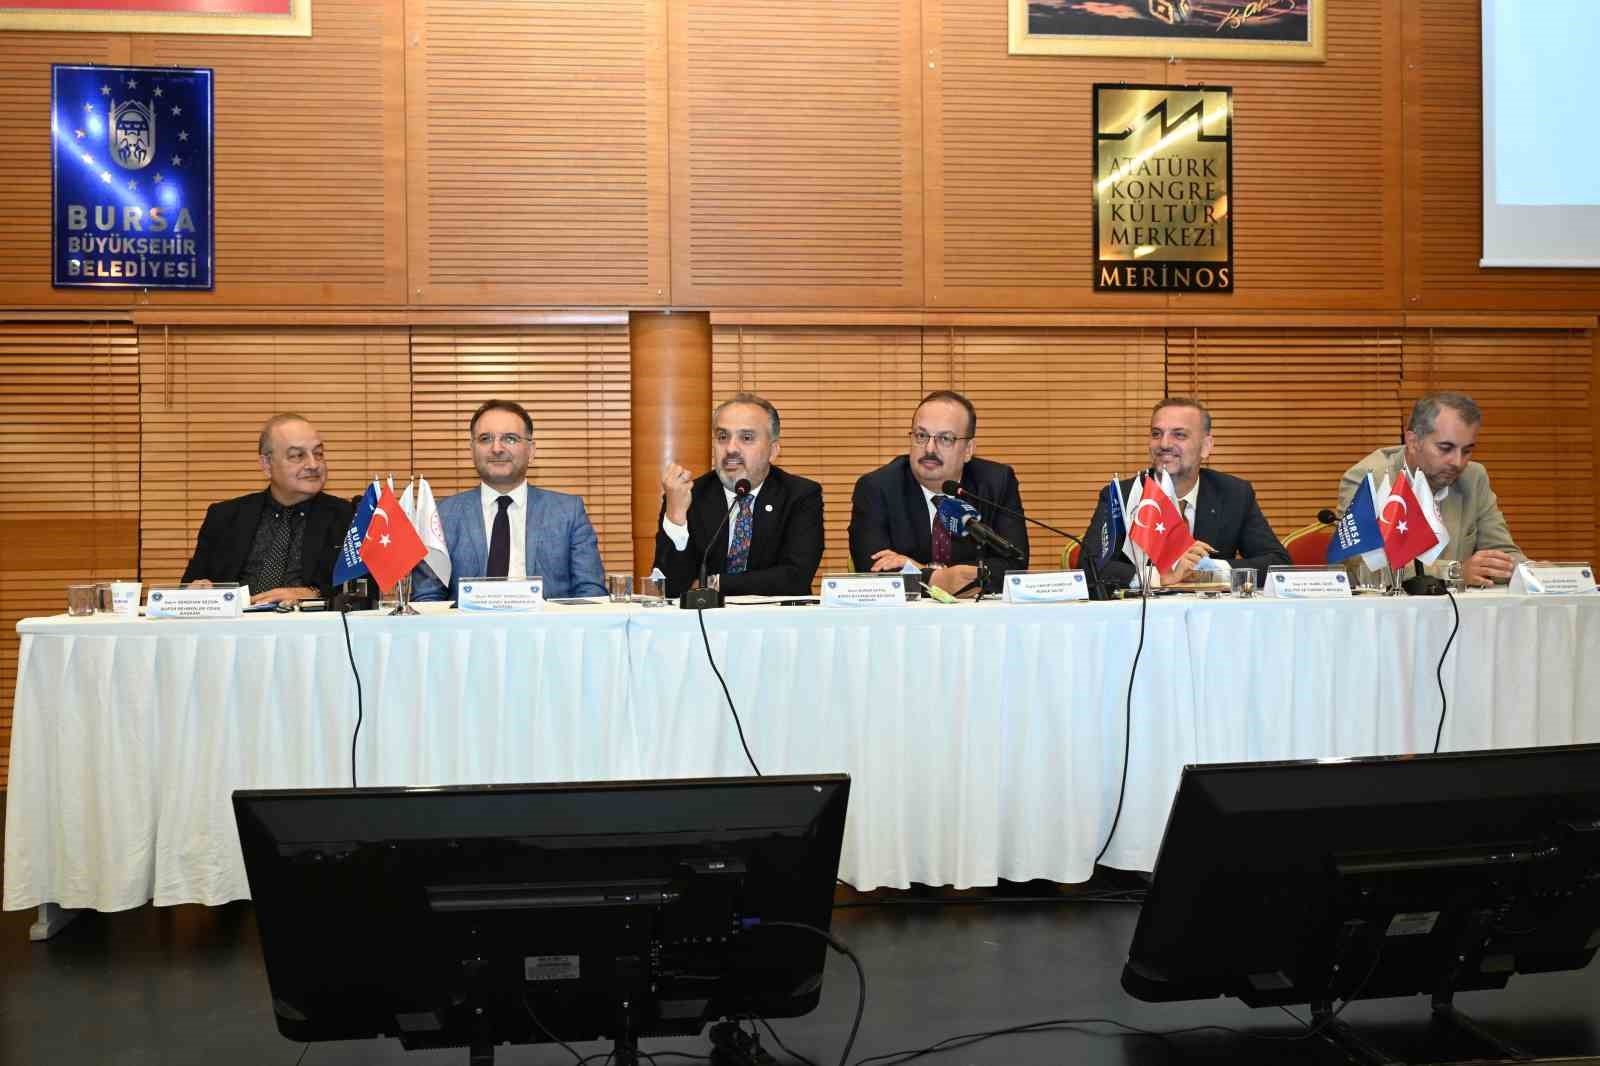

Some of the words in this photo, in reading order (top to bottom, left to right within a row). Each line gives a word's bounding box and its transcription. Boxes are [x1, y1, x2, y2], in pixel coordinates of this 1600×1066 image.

[1110, 154, 1217, 178] ATATÜRK
[1111, 180, 1217, 200] KONGRE
[68, 205, 196, 232] BURSA
[1111, 201, 1217, 224] KÜLTÜR
[68, 232, 196, 256] BÜYÜKŞEHİR
[1110, 223, 1216, 247] MERKEZİ
[68, 255, 196, 278] BELEDİYESİ
[1100, 265, 1229, 287] MERİNOS
[1346, 513, 1361, 544] BURSA
